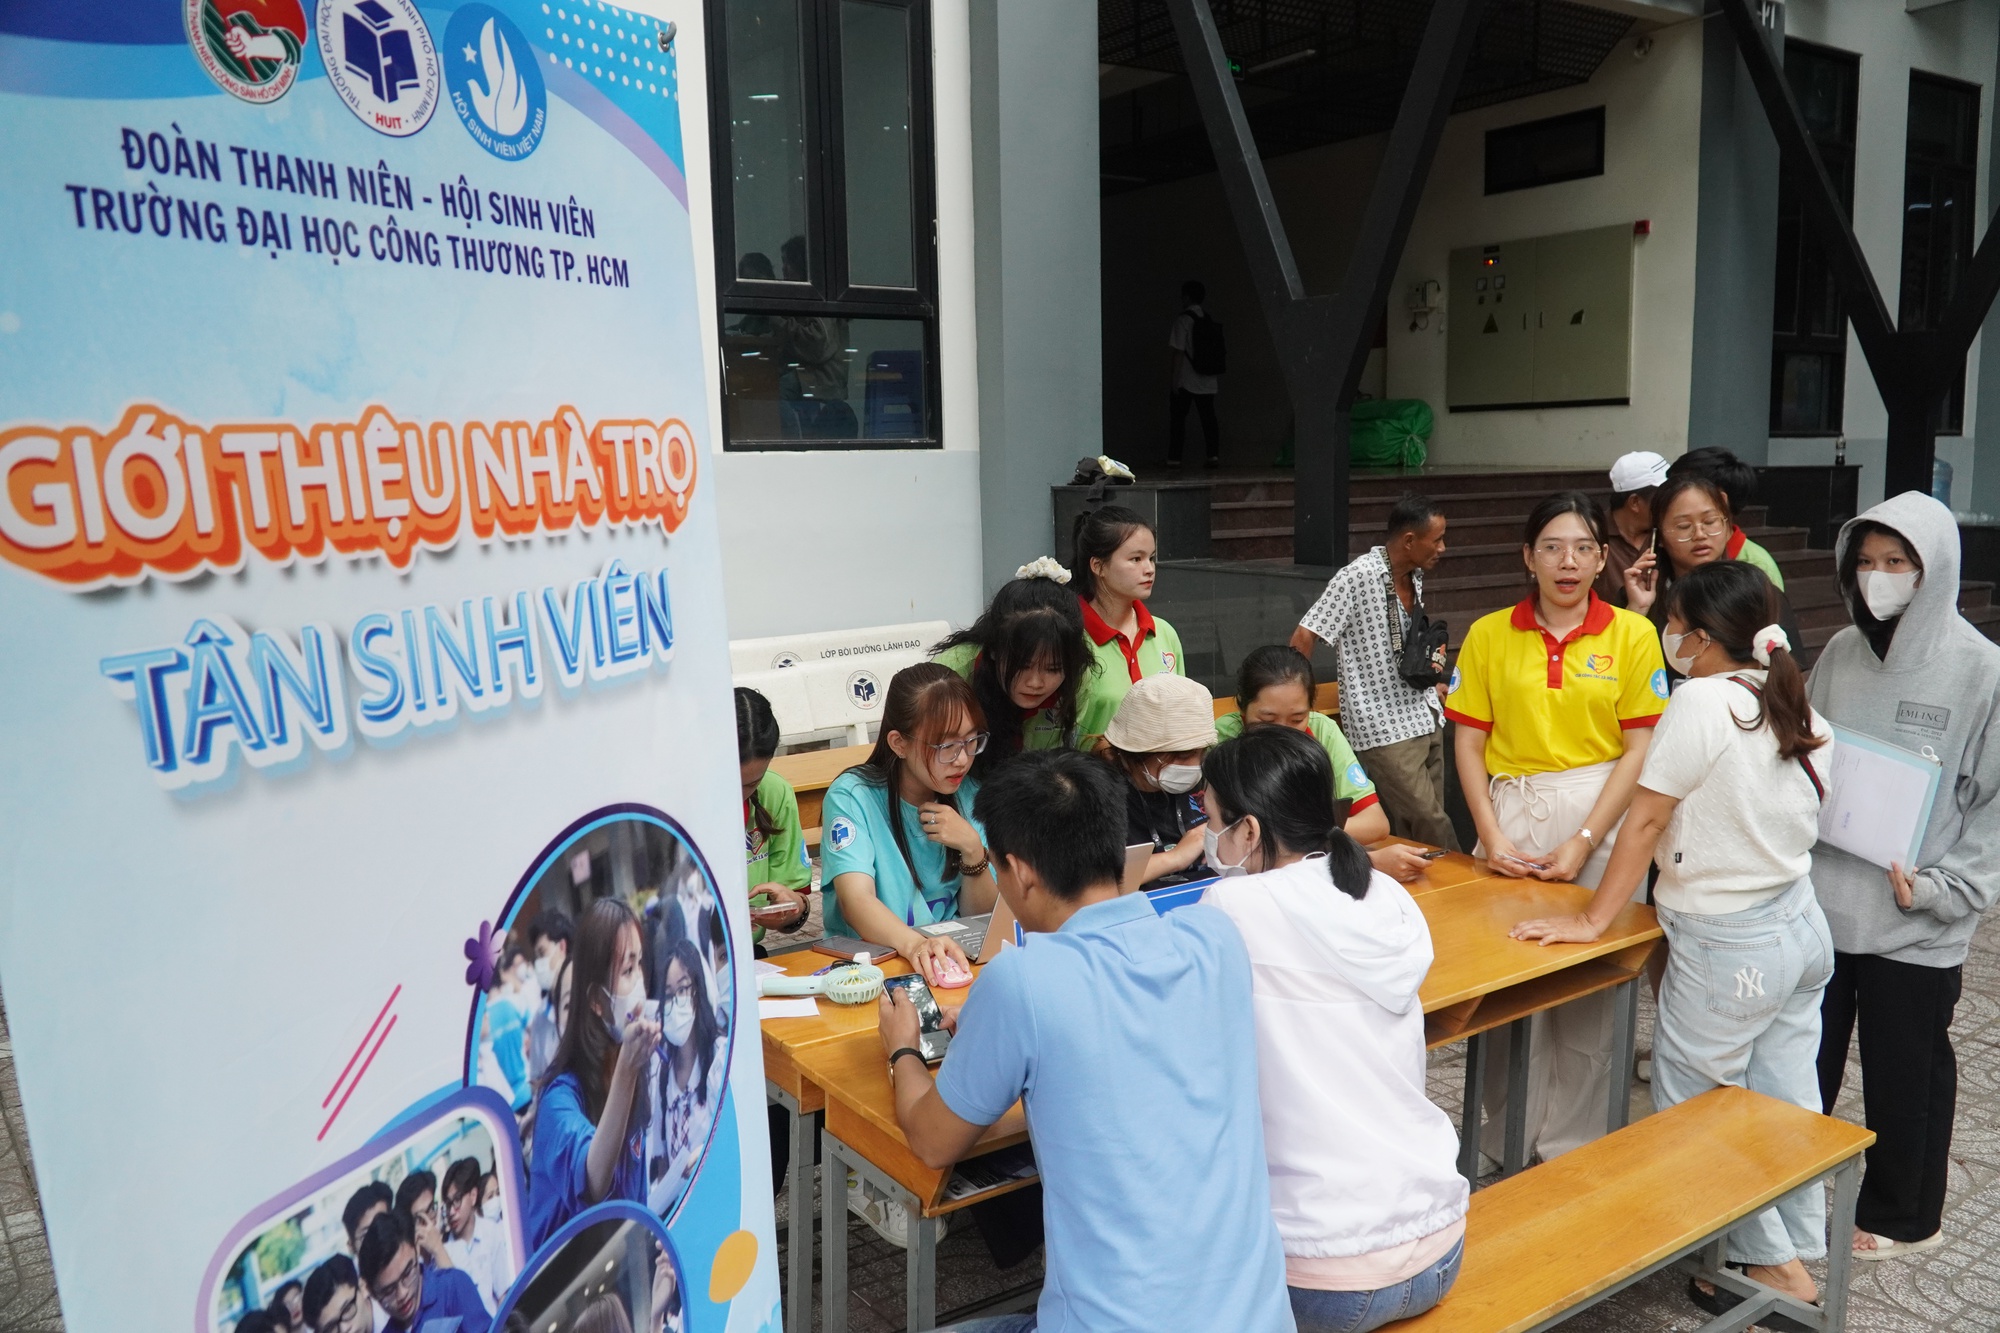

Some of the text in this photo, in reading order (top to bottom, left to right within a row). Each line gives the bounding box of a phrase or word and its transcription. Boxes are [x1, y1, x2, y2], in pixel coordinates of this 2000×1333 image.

[375, 112, 402, 129] HUIT
[452, 91, 545, 157] HỘI SINH VIÊN VIỆT NAM
[65, 180, 630, 288] TRƯỜNG ĐẠI HỌC CÔNG THƯƠNG TP. HCM
[121, 121, 222, 182] ĐOÀN
[229, 145, 339, 200] THANH
[346, 159, 415, 211] NIÊN
[440, 174, 482, 229] HỘI
[488, 191, 543, 231] SINH
[547, 195, 595, 239] VIÊN
[0, 409, 694, 550] GIỚI THIỆU NHÀ TRỌ
[101, 558, 674, 774] TÂN SINH VIÊN
[820, 648, 836, 659] LỚP
[904, 640, 921, 650] ĐẠO
